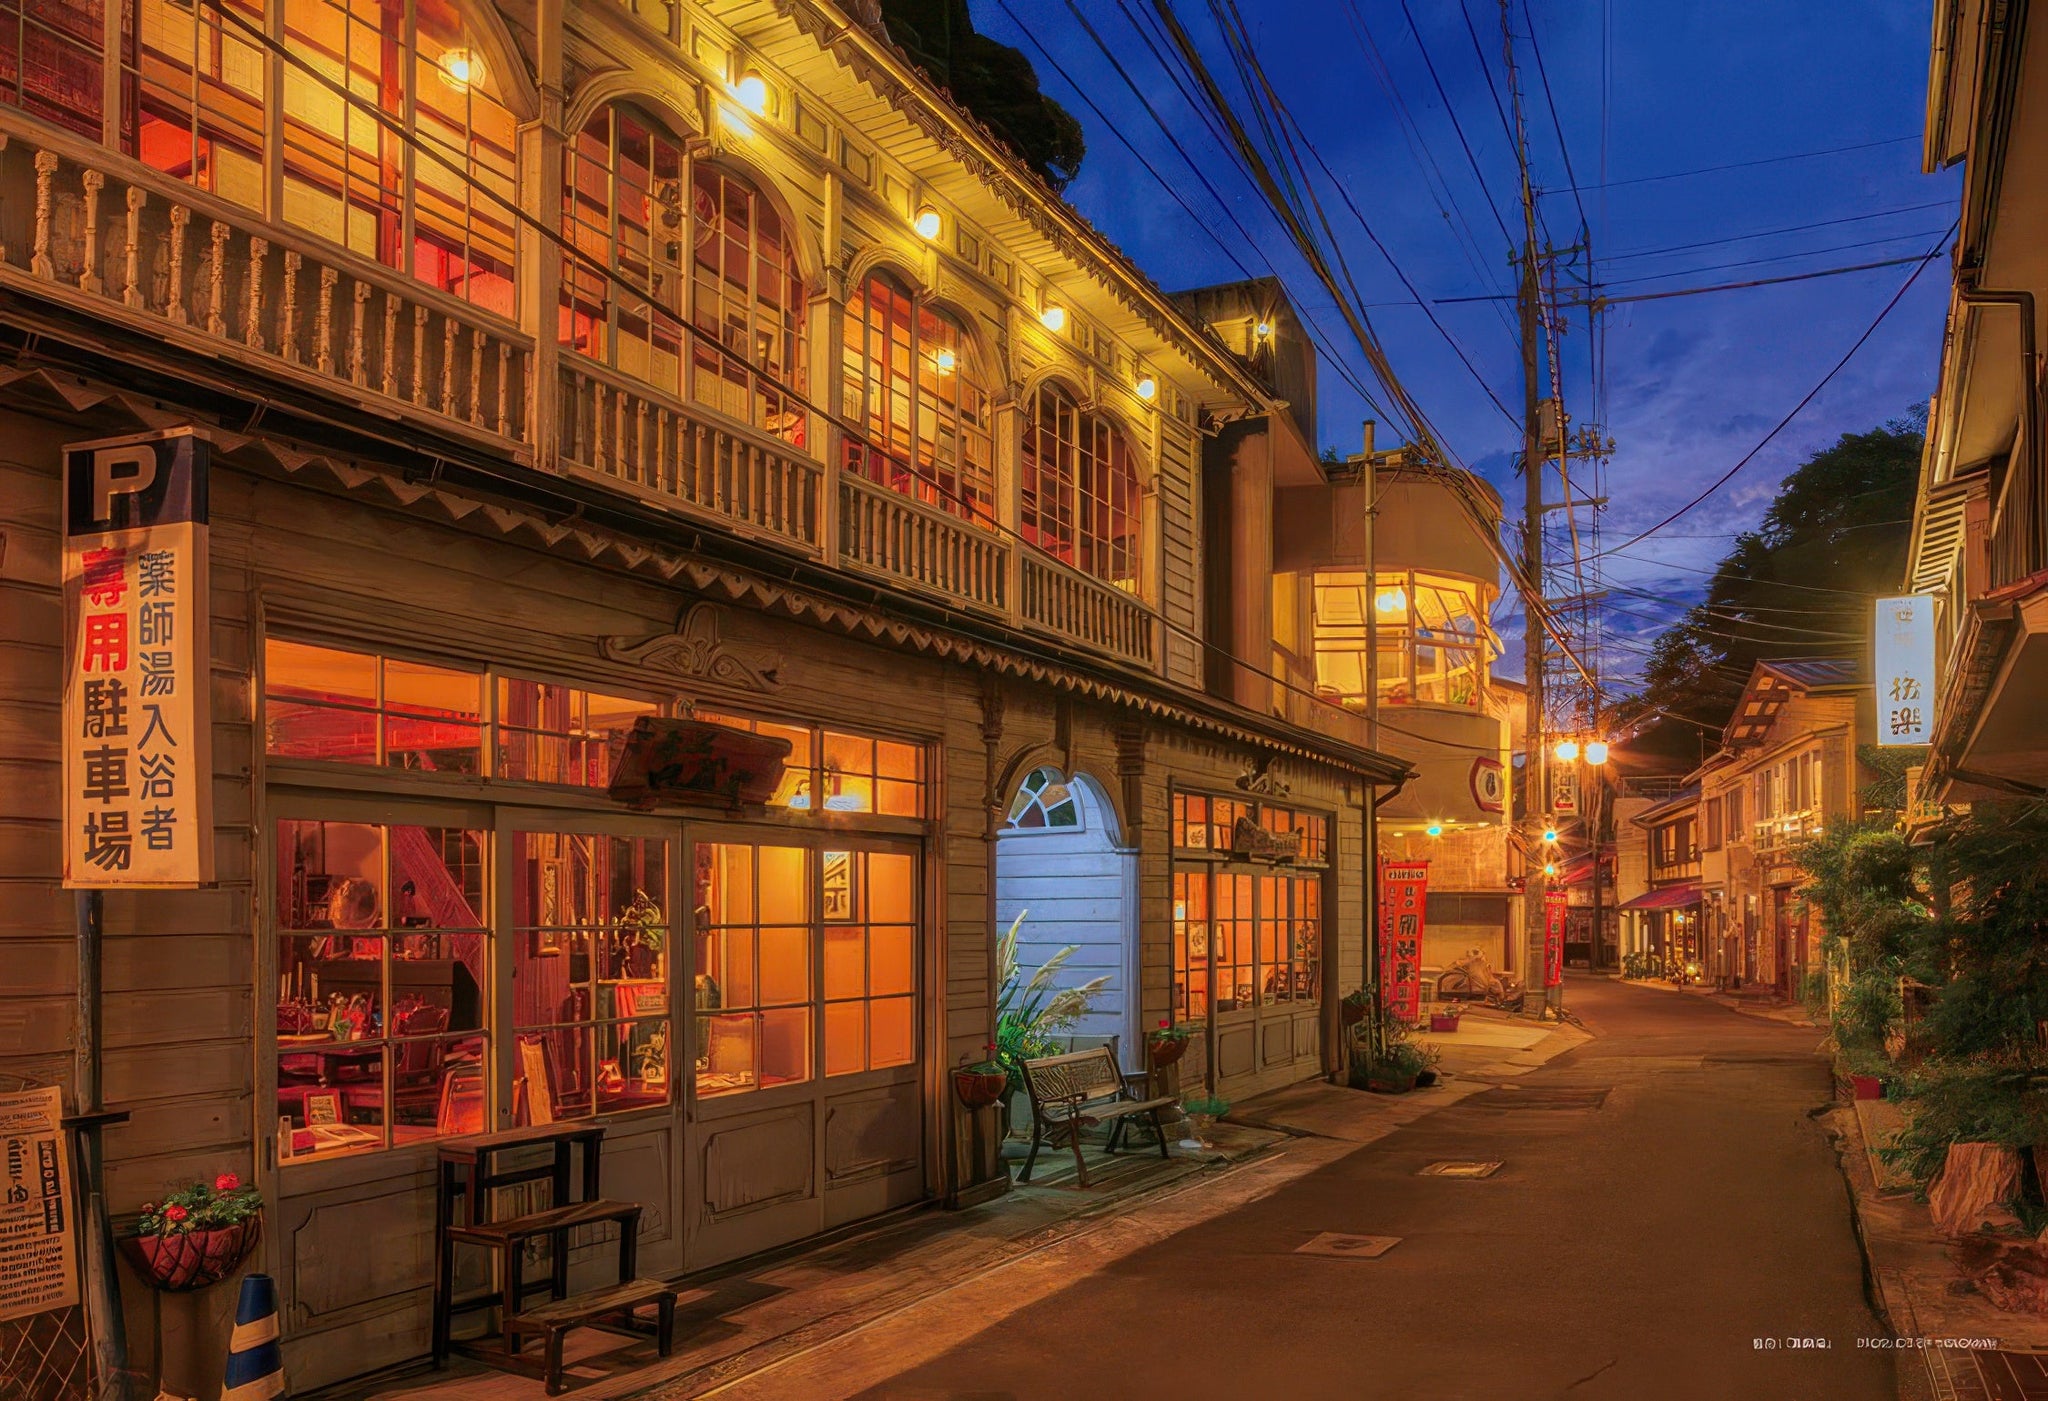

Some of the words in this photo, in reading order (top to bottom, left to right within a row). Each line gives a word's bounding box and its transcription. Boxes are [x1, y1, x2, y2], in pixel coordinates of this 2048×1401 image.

[93, 445, 157, 521] P
[82, 547, 132, 871] 専用駐車場
[138, 551, 177, 850] 薬師湯入浴者
